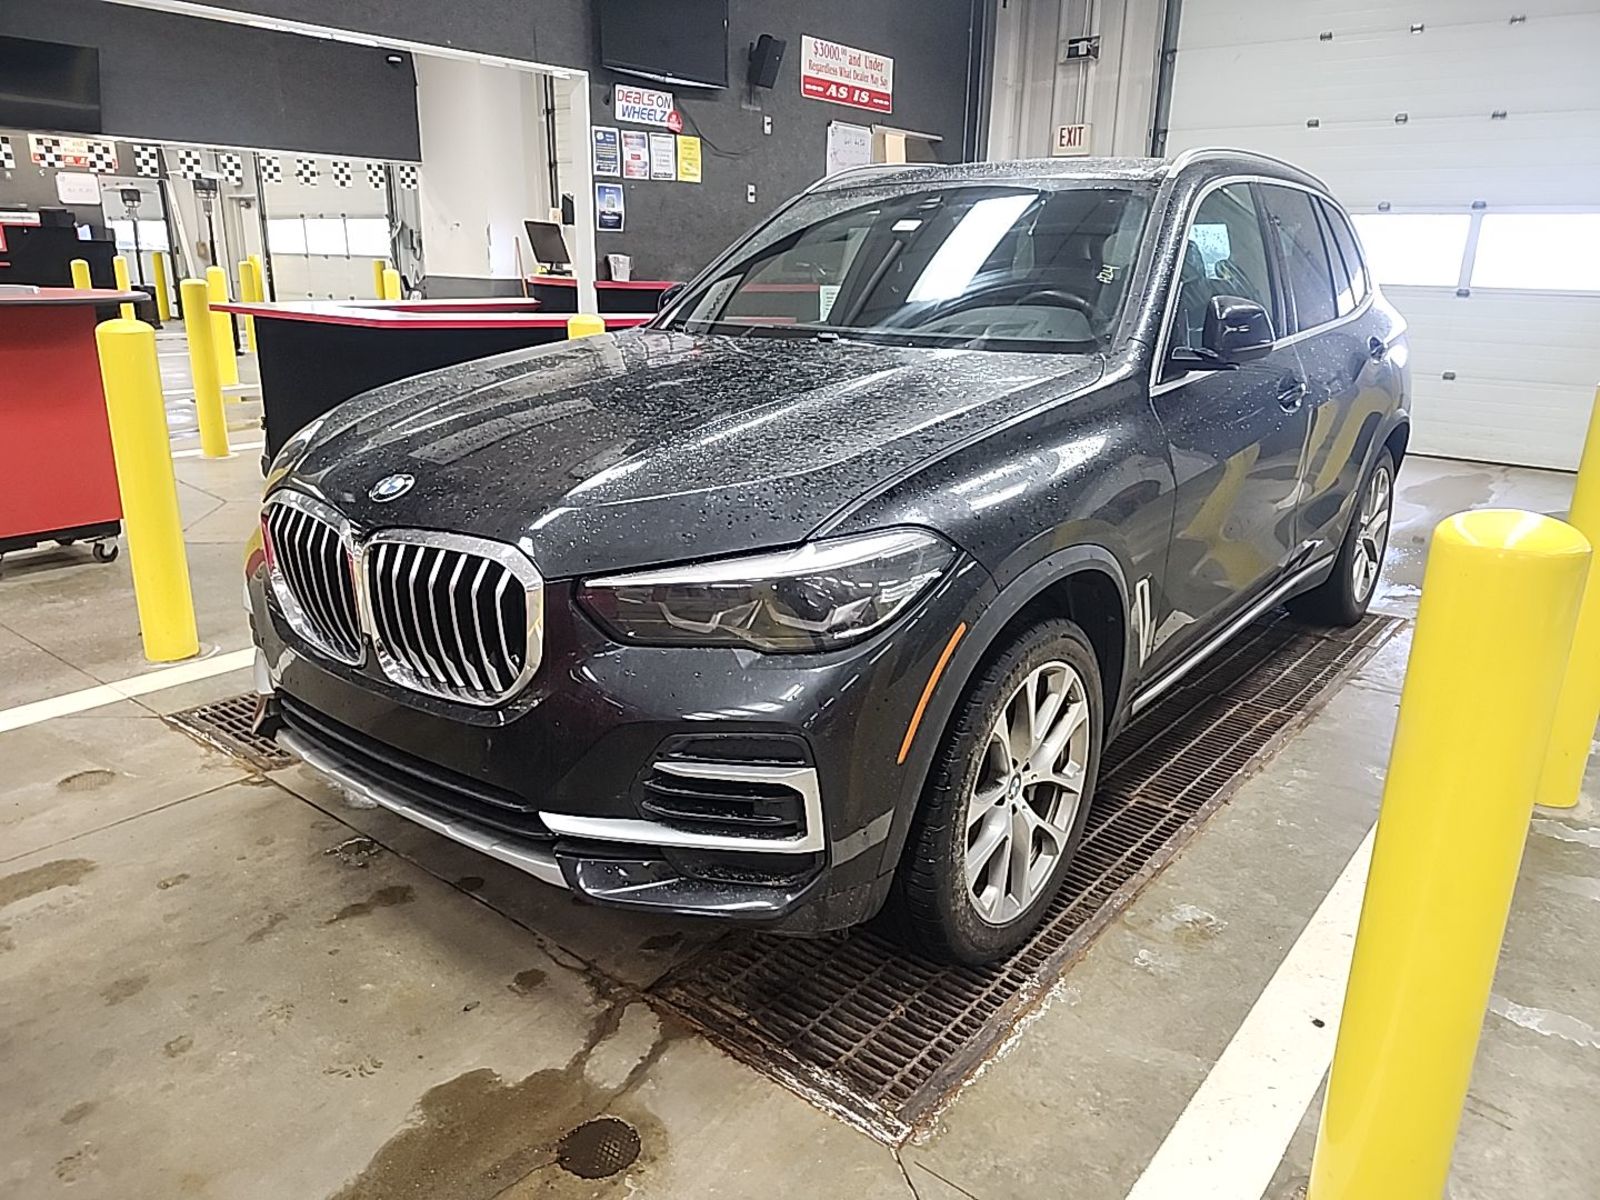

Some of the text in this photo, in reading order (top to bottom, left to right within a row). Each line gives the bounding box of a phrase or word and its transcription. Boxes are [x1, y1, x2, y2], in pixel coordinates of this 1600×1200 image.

[808, 59, 838, 75] Regardless
[838, 66, 852, 79] What
[852, 69, 870, 84] Dealer
[848, 53, 861, 67] and
[864, 55, 884, 73] Under
[656, 95, 671, 109] ON
[826, 84, 870, 103] AS IS
[621, 104, 668, 122] WHEELZ
[1059, 126, 1084, 147] EXIT
